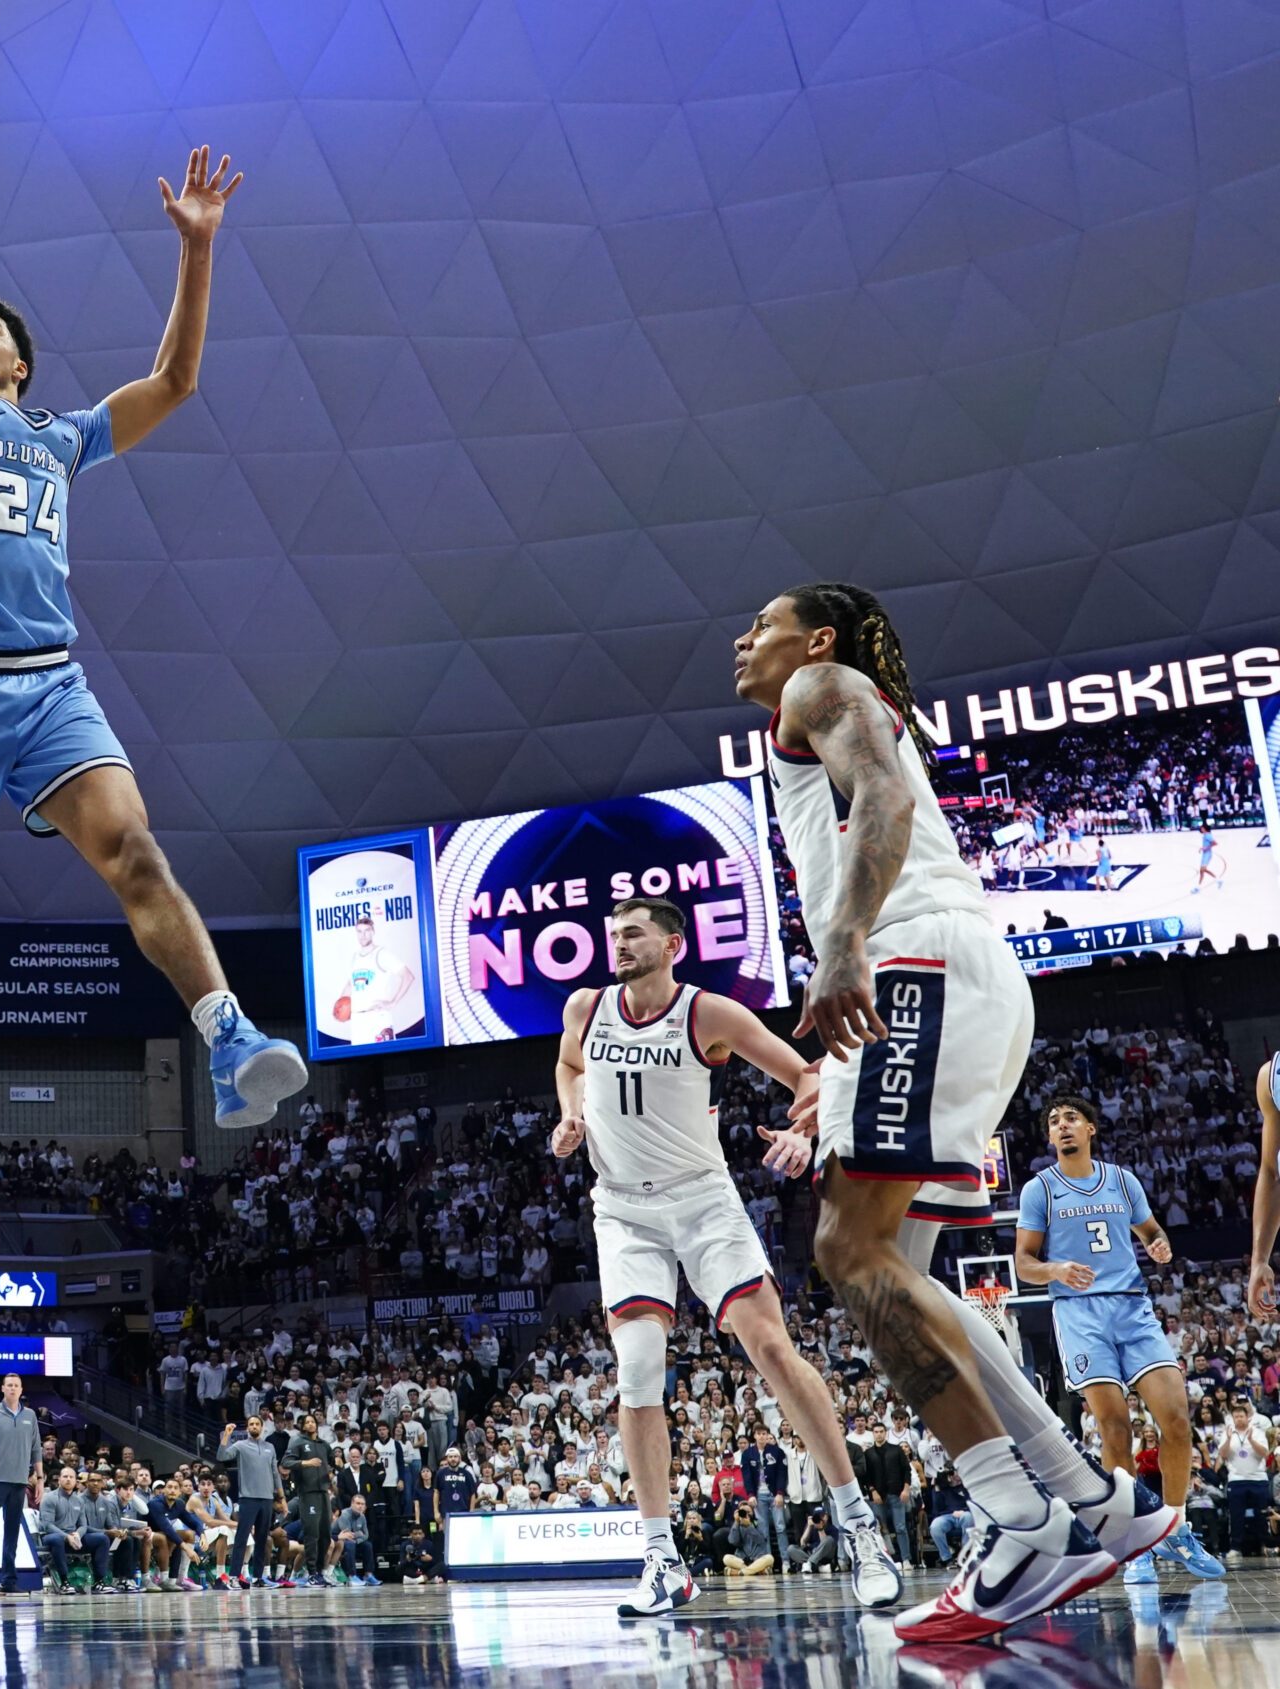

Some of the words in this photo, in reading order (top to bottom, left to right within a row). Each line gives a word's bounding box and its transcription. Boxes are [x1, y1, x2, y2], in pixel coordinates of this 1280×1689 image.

[966, 646, 1280, 740] HUSKIES
[335, 889, 354, 898] CAM
[355, 883, 395, 896] SPENCER
[461, 877, 589, 921] MAKE
[610, 857, 743, 901] SOME
[315, 901, 372, 931] HUSKIES
[384, 895, 414, 922] NBA
[1103, 926, 1128, 946] 17
[19, 943, 110, 955] CONFERENCE
[9, 957, 120, 969] CHAMPIONSHIPS
[53, 982, 121, 996] SEASON
[589, 1041, 682, 1068] UCONN
[875, 981, 922, 1151] HUSKIES
[10, 1090, 26, 1099] SEC
[36, 1088, 52, 1100] 14
[615, 1071, 644, 1116] 11
[1057, 1203, 1126, 1220] COLUMBIA
[1085, 1219, 1113, 1254] 3
[498, 1289, 536, 1311] WORLD
[17, 1352, 45, 1361] NOISE
